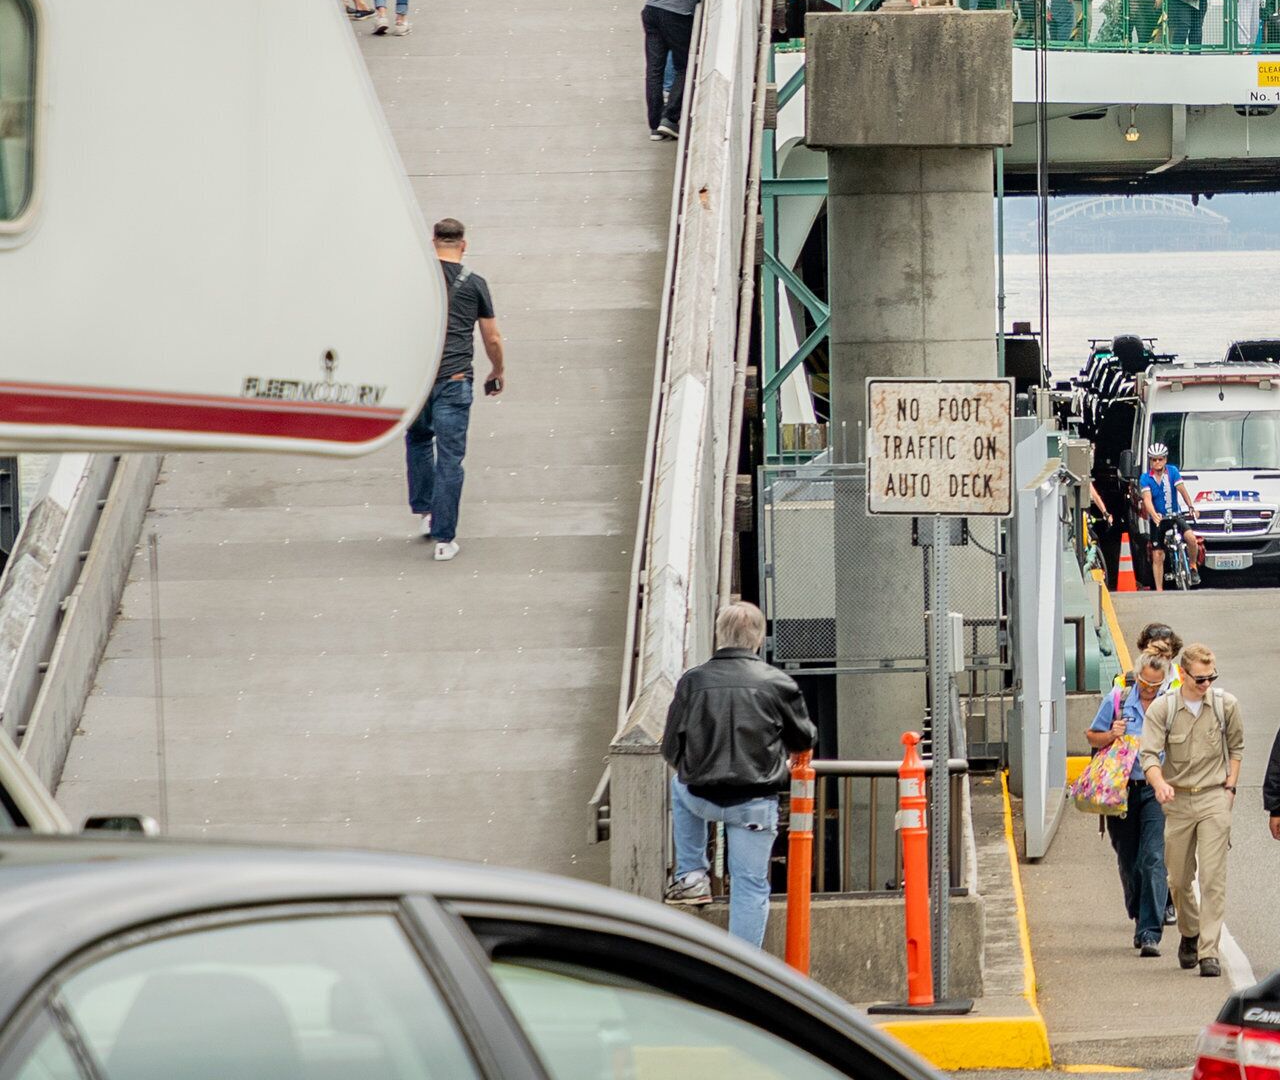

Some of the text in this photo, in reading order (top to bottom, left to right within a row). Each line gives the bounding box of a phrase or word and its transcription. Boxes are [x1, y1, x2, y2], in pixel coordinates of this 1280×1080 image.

[1250, 91, 1270, 101] No.
[1275, 91, 1280, 101] 1
[897, 398, 982, 422] NO FOOT
[883, 435, 997, 460] TRAFFIC ON
[885, 473, 993, 498] AUTO DECK
